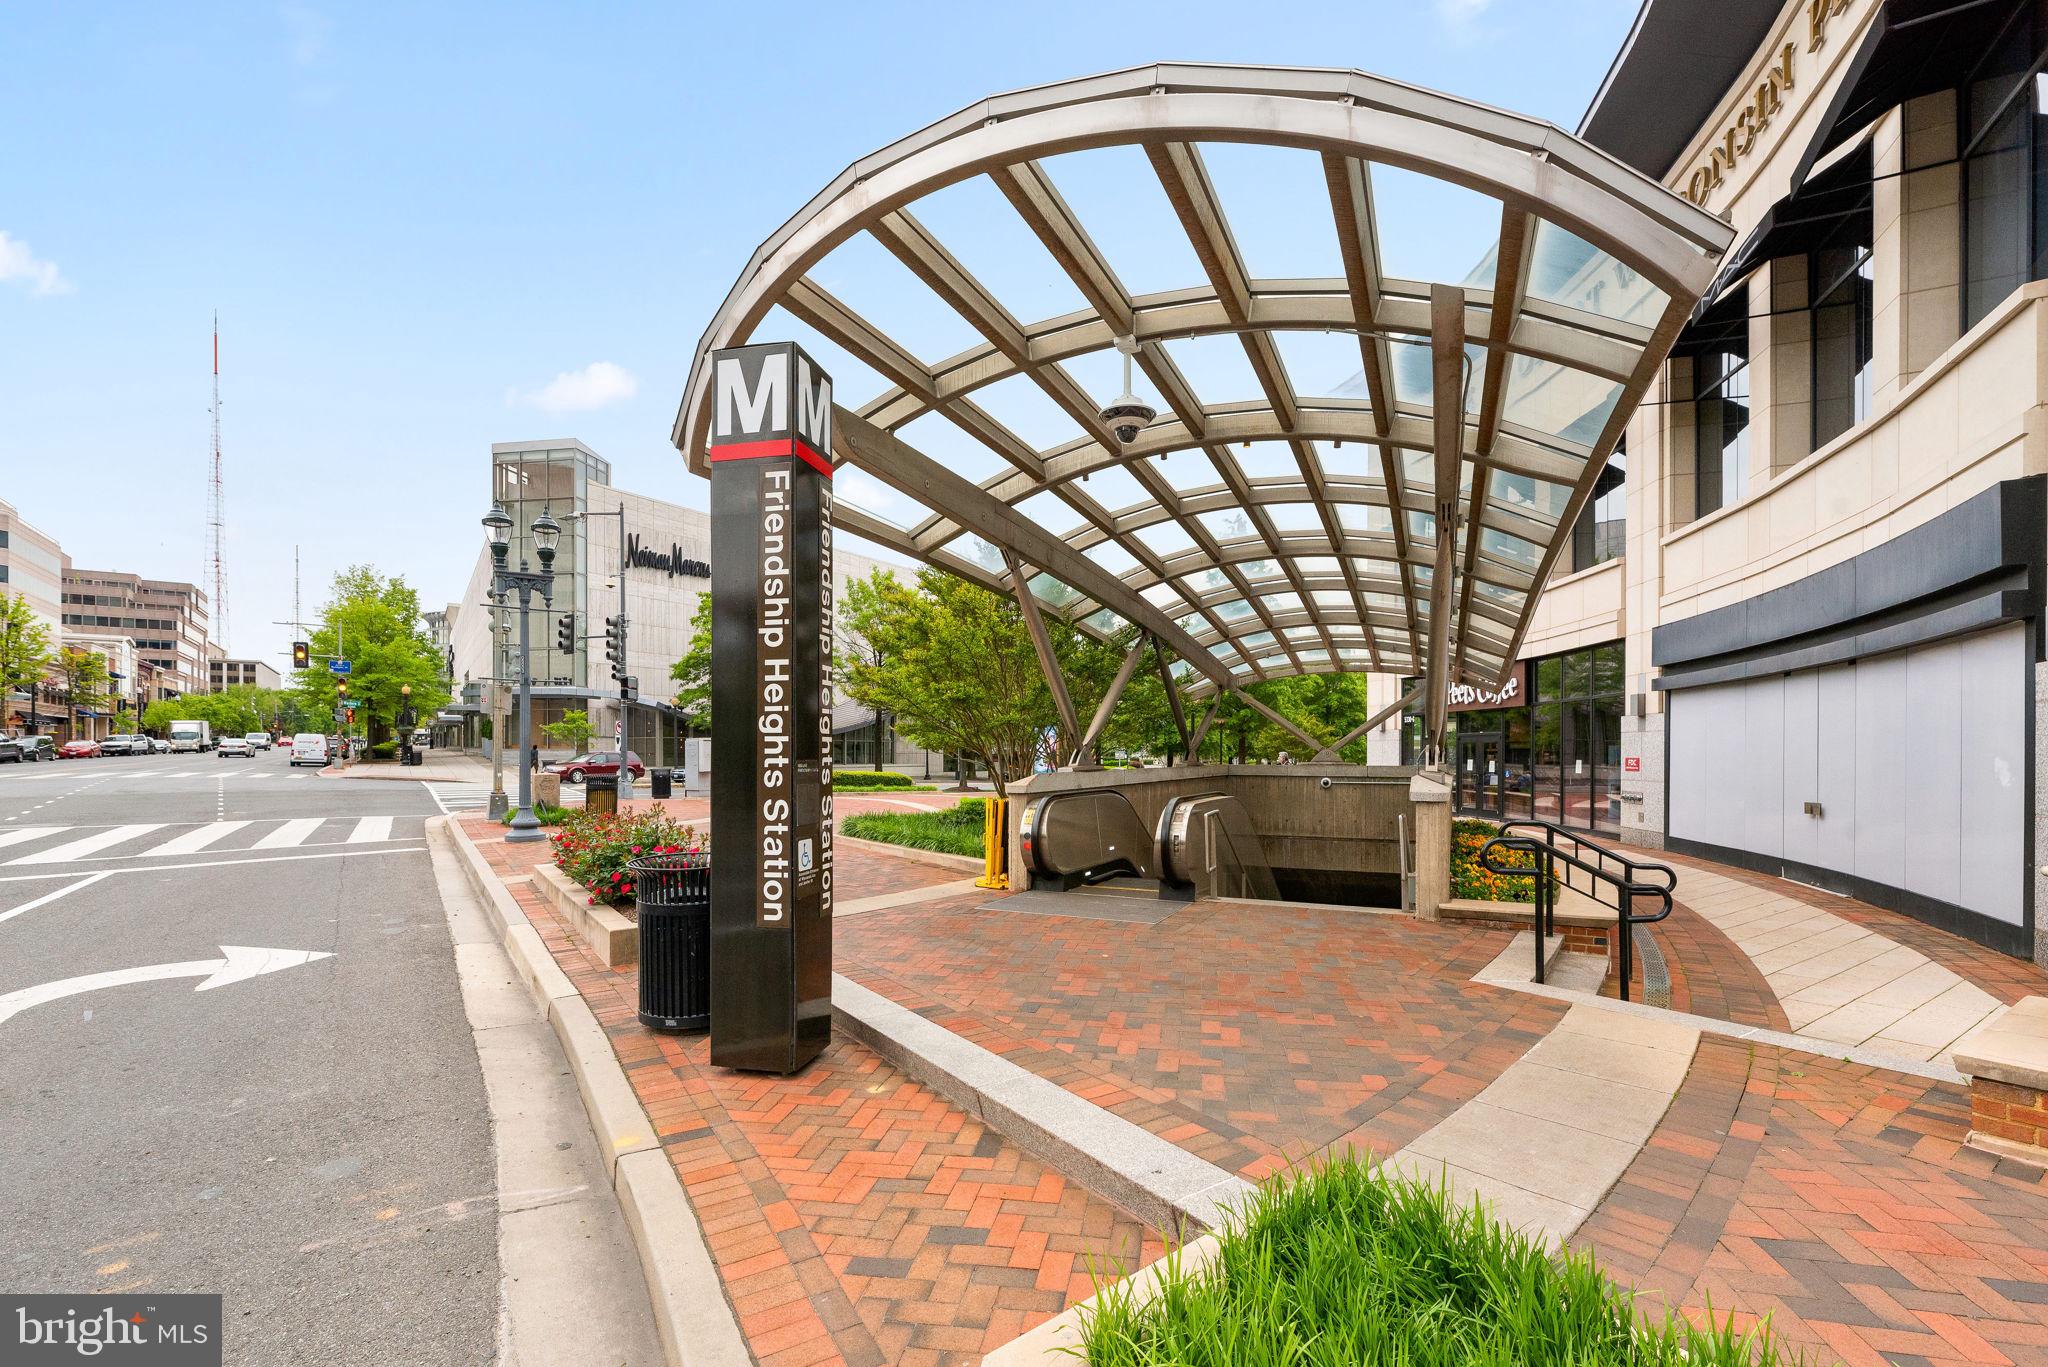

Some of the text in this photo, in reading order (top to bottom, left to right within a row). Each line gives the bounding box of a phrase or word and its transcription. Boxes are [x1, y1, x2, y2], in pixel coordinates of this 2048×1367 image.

[717, 353, 787, 436] M
[798, 355, 831, 456] M
[625, 532, 671, 571] Neiman
[758, 470, 790, 921] Friendship Heights Station
[819, 487, 833, 910] Friendship Heights Station
